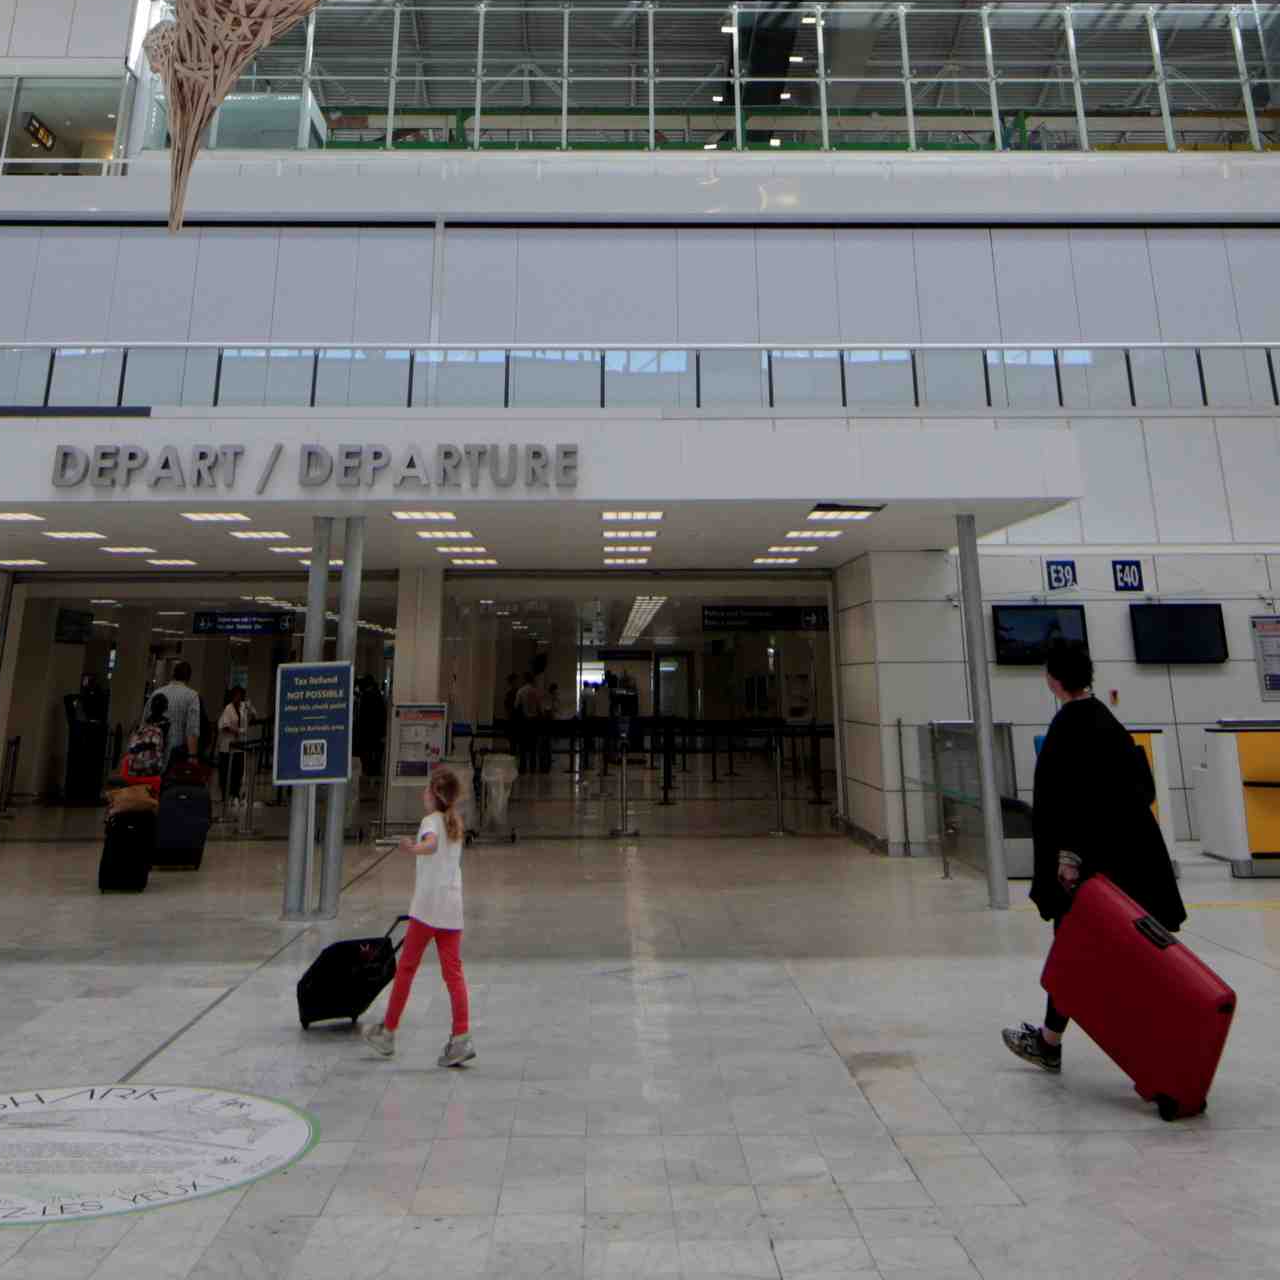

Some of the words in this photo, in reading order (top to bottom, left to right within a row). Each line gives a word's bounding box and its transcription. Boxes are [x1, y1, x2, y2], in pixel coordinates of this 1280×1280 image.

[51, 443, 246, 489] DEPART
[298, 442, 579, 489] DEPARTURE
[1050, 564, 1074, 588] E39
[1115, 563, 1140, 588] E40
[305, 688, 345, 699] POSSIBLE
[304, 742, 324, 755] TAX
